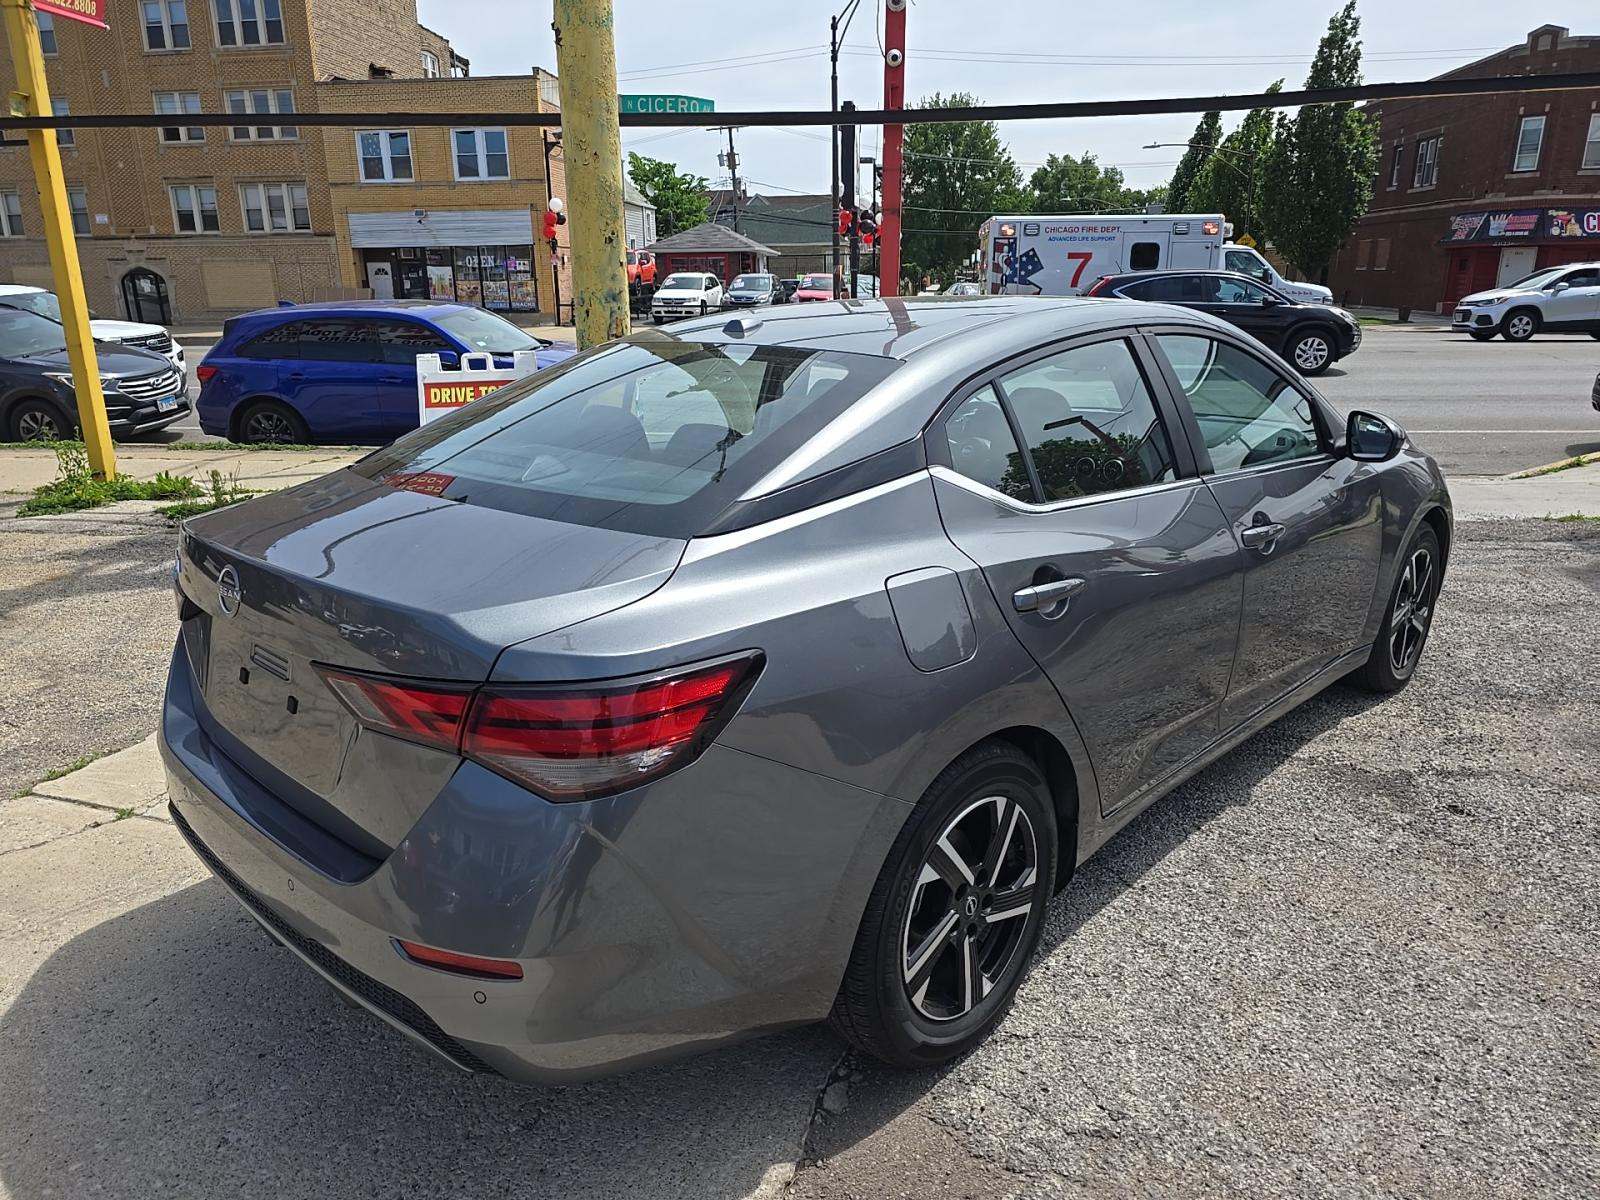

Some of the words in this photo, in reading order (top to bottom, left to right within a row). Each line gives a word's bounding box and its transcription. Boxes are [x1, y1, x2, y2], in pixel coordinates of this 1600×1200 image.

[627, 101, 633, 109] N
[637, 97, 699, 112] CICERO
[465, 255, 495, 267] OPEN
[1067, 252, 1093, 288] 7
[430, 386, 475, 404] DRIVE
